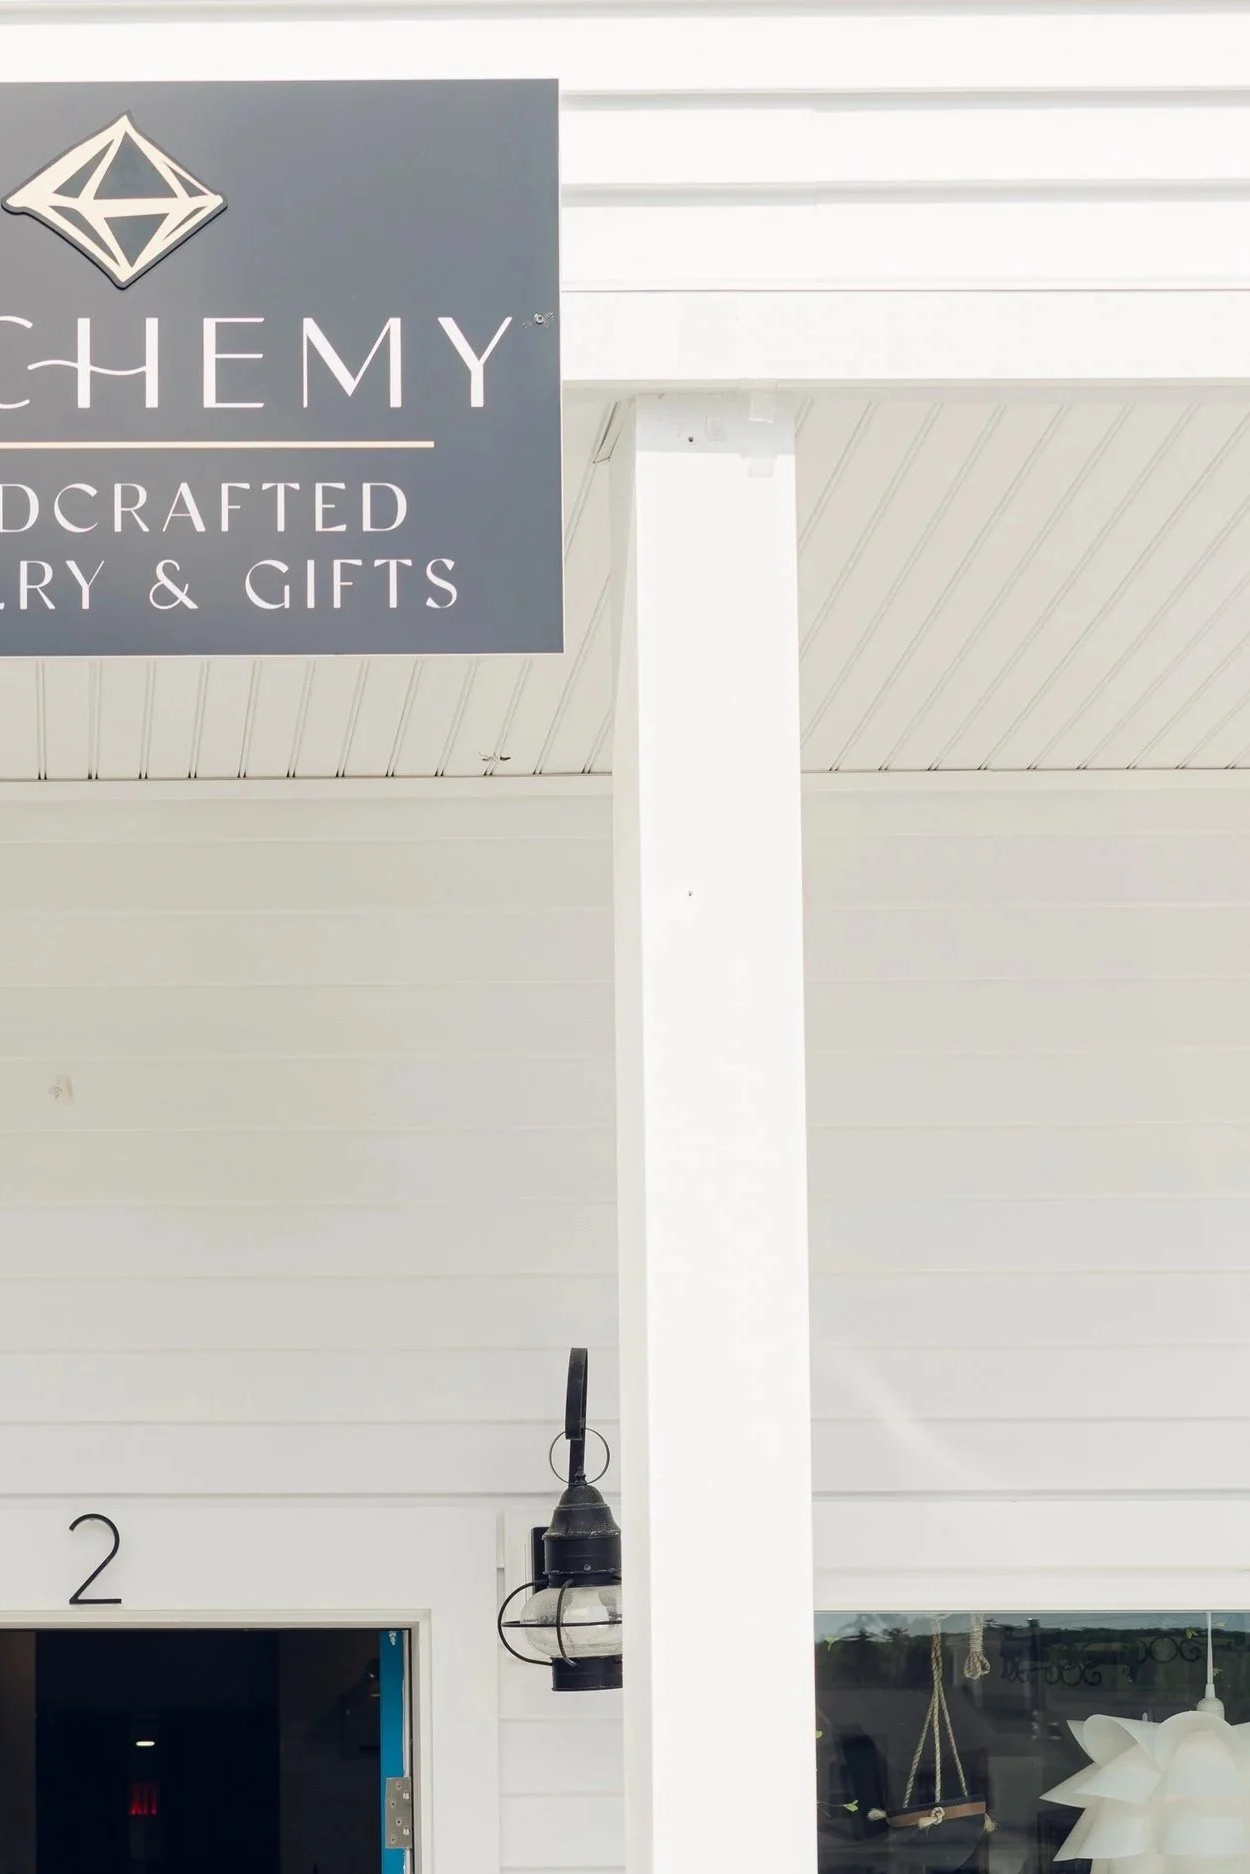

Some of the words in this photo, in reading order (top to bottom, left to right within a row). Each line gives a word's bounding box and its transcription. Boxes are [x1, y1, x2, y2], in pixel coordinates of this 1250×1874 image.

[149, 559, 199, 610] &
[244, 558, 458, 610] GIFTS
[68, 1513, 122, 1605] 2
